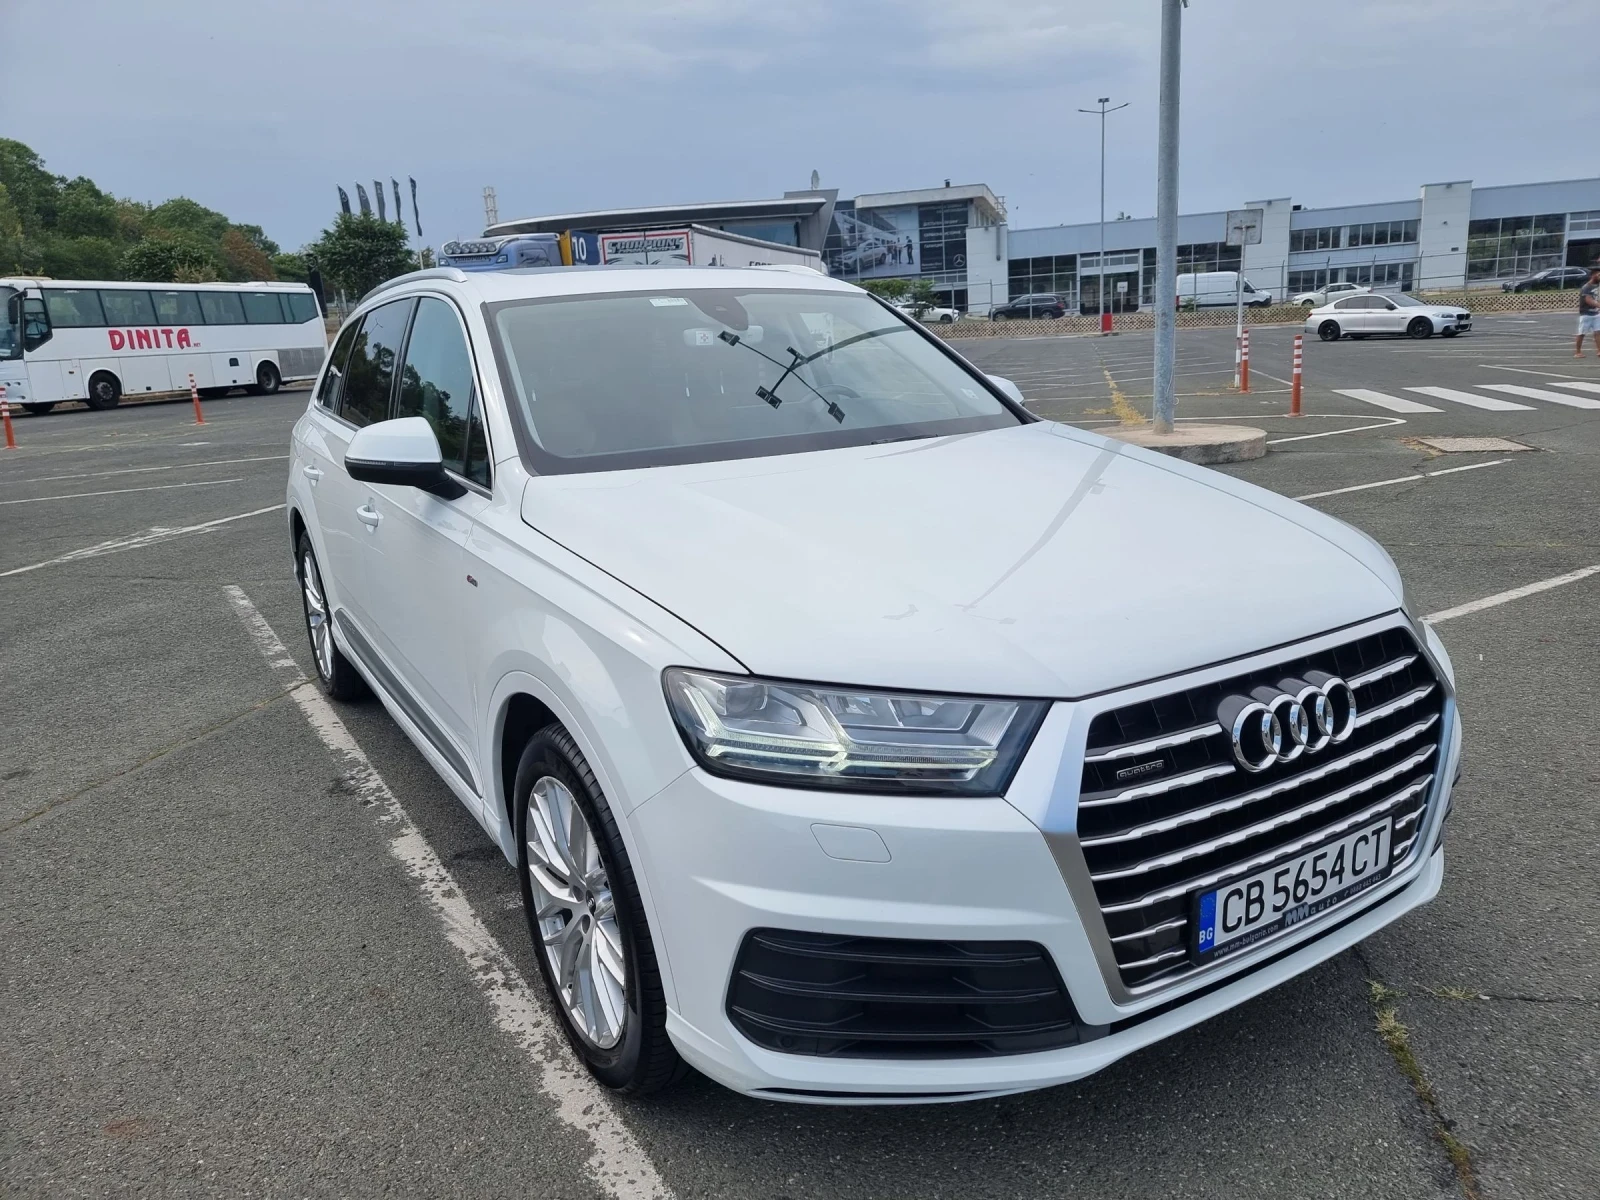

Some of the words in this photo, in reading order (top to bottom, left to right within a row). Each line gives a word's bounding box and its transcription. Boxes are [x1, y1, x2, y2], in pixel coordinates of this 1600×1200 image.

[108, 328, 191, 350] DINITA
[1222, 879, 1265, 934] CB
[1272, 843, 1346, 913] 5654
[1351, 824, 1388, 877] CT
[1199, 927, 1213, 944] BG
